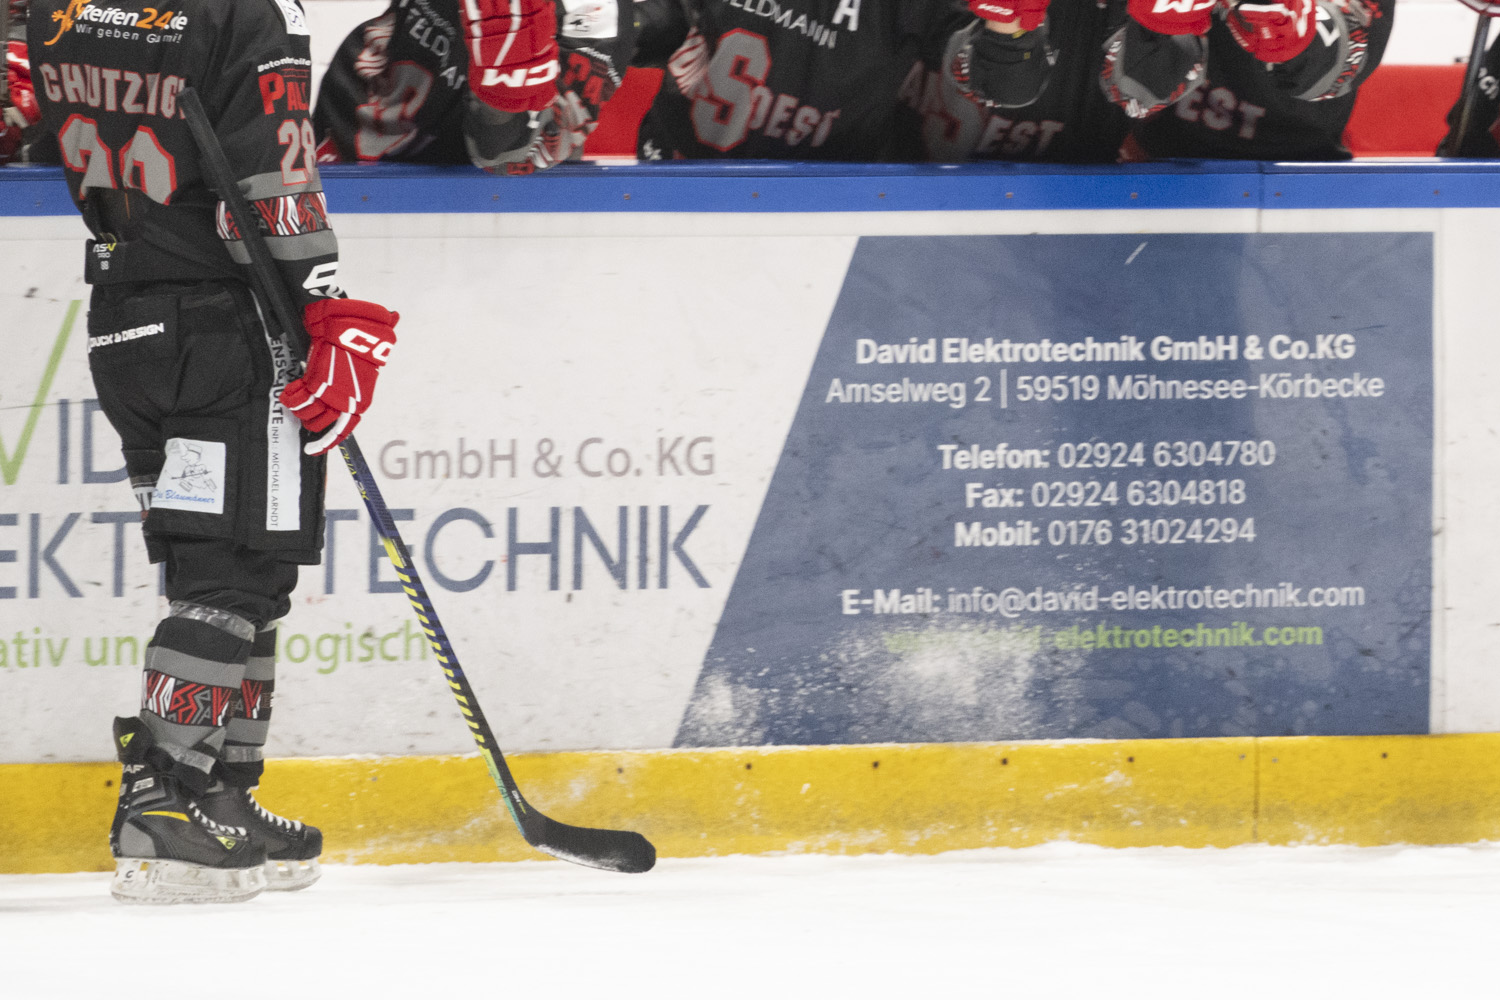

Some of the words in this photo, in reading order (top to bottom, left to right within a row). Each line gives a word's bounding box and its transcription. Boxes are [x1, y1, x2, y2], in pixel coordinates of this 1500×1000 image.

[75, 23, 93, 35] Wir
[97, 27, 140, 42] geben
[277, 117, 317, 187] 28
[122, 322, 165, 343] DESIGN
[856, 337, 937, 364] David
[942, 335, 1146, 364] Elektrotechnik
[1149, 334, 1239, 362] GmbH
[1243, 334, 1264, 361] &
[1268, 332, 1357, 361] Co.KG
[824, 373, 967, 409] Amselweg
[972, 376, 992, 402] 2
[1016, 376, 1100, 402] 59519
[1107, 370, 1386, 401] Möhnesee-Körbecke
[378, 437, 518, 481] GmbH
[533, 437, 564, 479] &
[576, 437, 643, 478] Co.
[657, 435, 716, 477] KG
[938, 443, 1050, 470] Telefon:
[1058, 441, 1146, 468] 02924
[1153, 440, 1277, 468] 6304780
[270, 451, 280, 494] MICHAEL
[965, 482, 1025, 509] Fax:
[1031, 480, 1120, 508] 02924
[1126, 478, 1247, 507] 6304818
[269, 496, 280, 528] ARNDT
[954, 520, 1041, 548] Mobil:
[1048, 519, 1113, 546] 0176
[1120, 517, 1257, 545] 31024294
[841, 587, 941, 616] E-Mail:
[947, 581, 1366, 619] info@david-elektrotechnik.com
